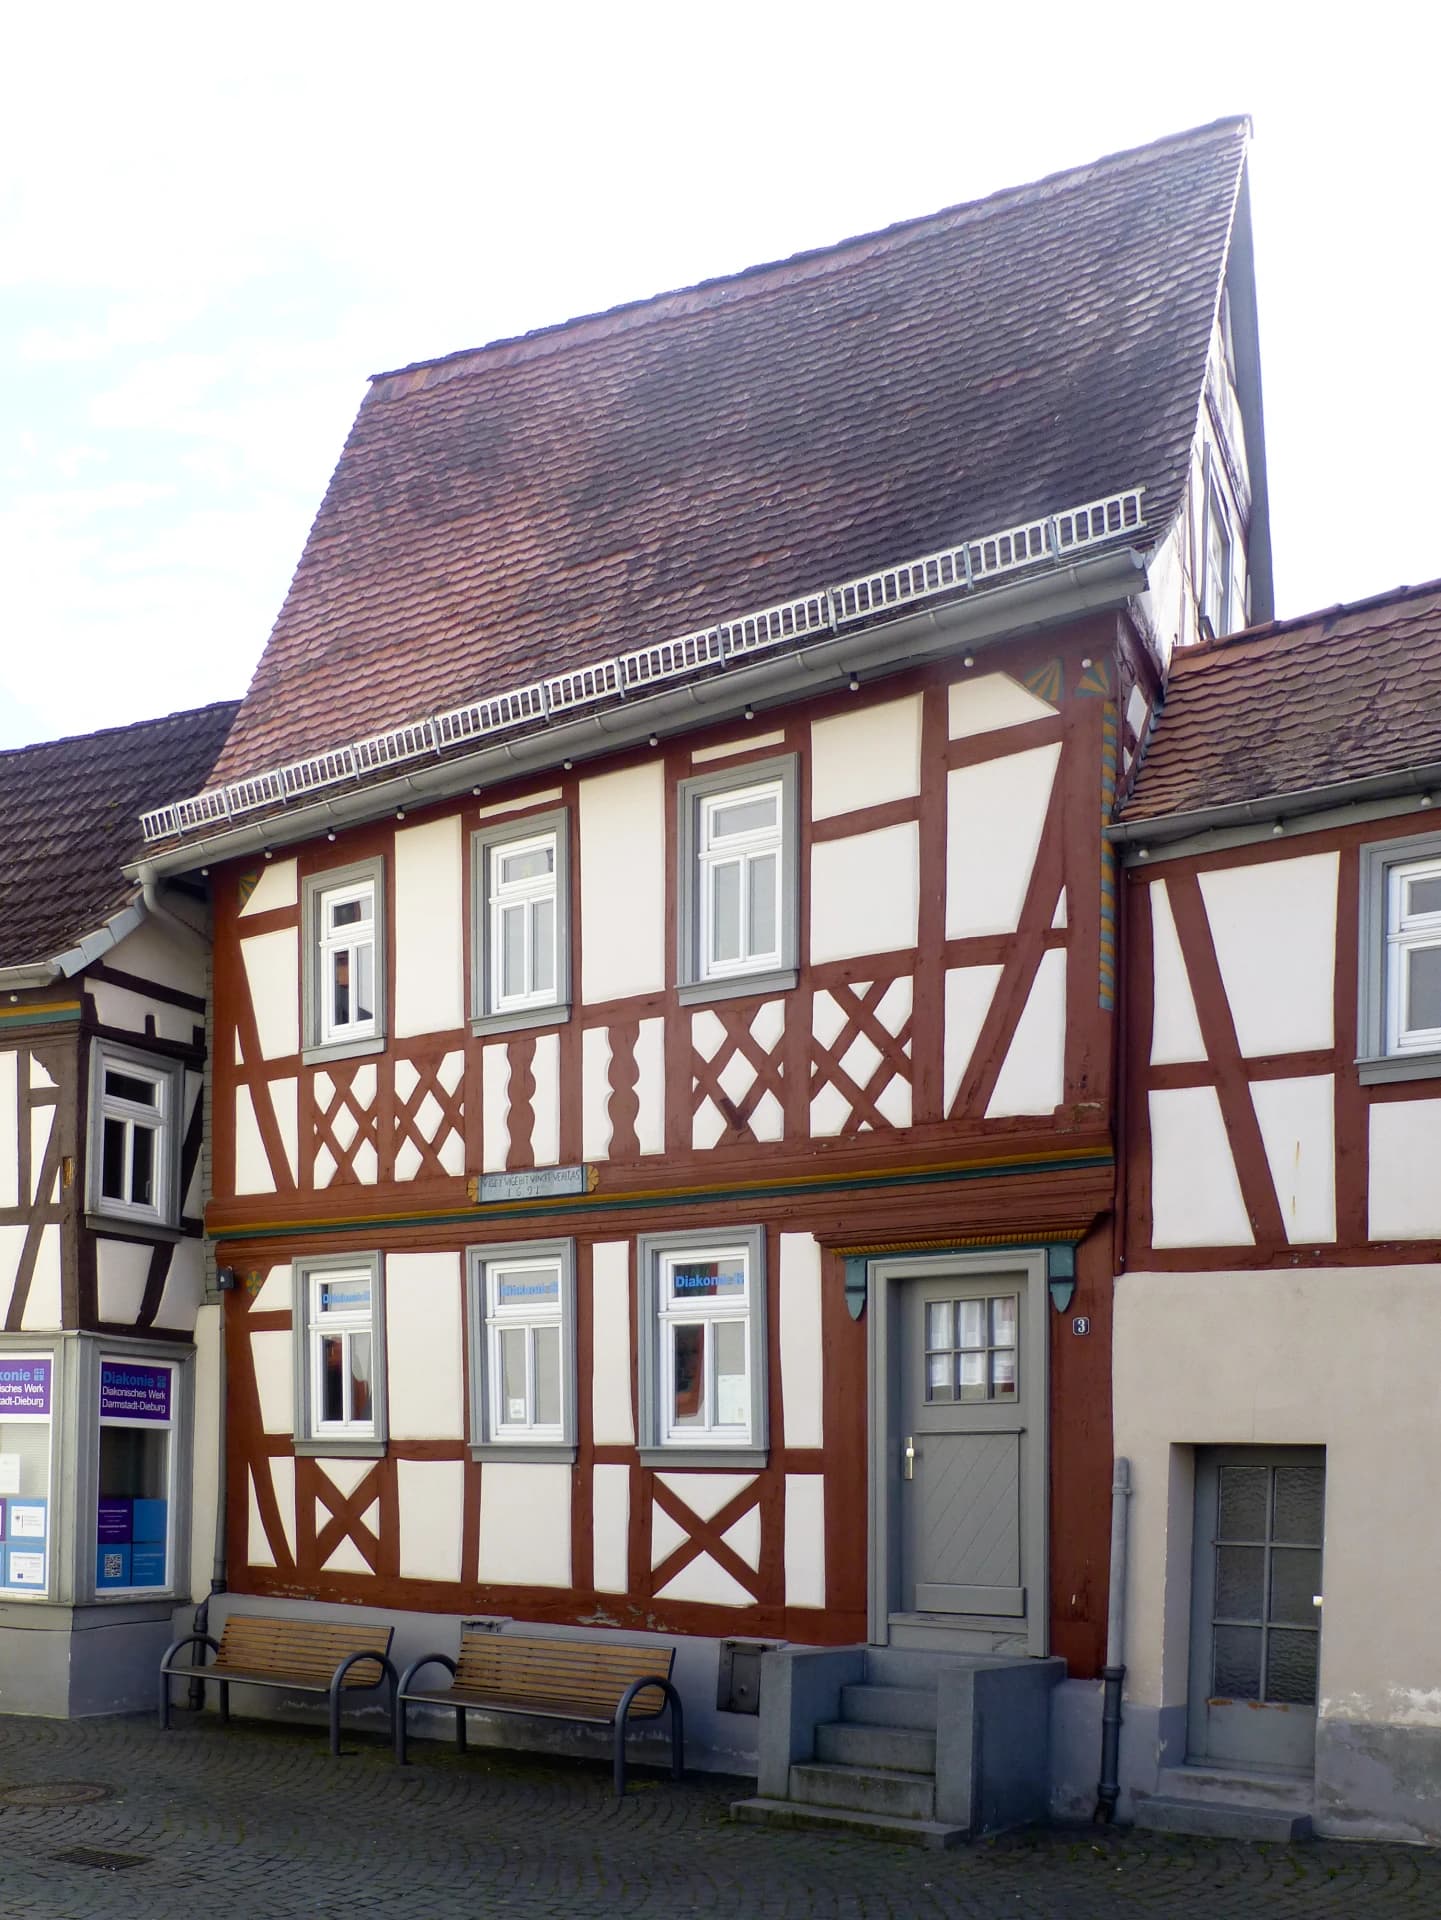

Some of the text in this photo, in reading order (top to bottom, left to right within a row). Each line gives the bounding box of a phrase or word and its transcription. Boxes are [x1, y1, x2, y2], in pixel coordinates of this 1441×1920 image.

[1078, 1319, 1086, 1333] 3
[103, 1371, 154, 1387] Diakonie
[24, 1383, 44, 1394] Werk
[102, 1386, 166, 1400] Diakonisches Werk
[102, 1399, 166, 1414] Darmstadt-Dieburg
